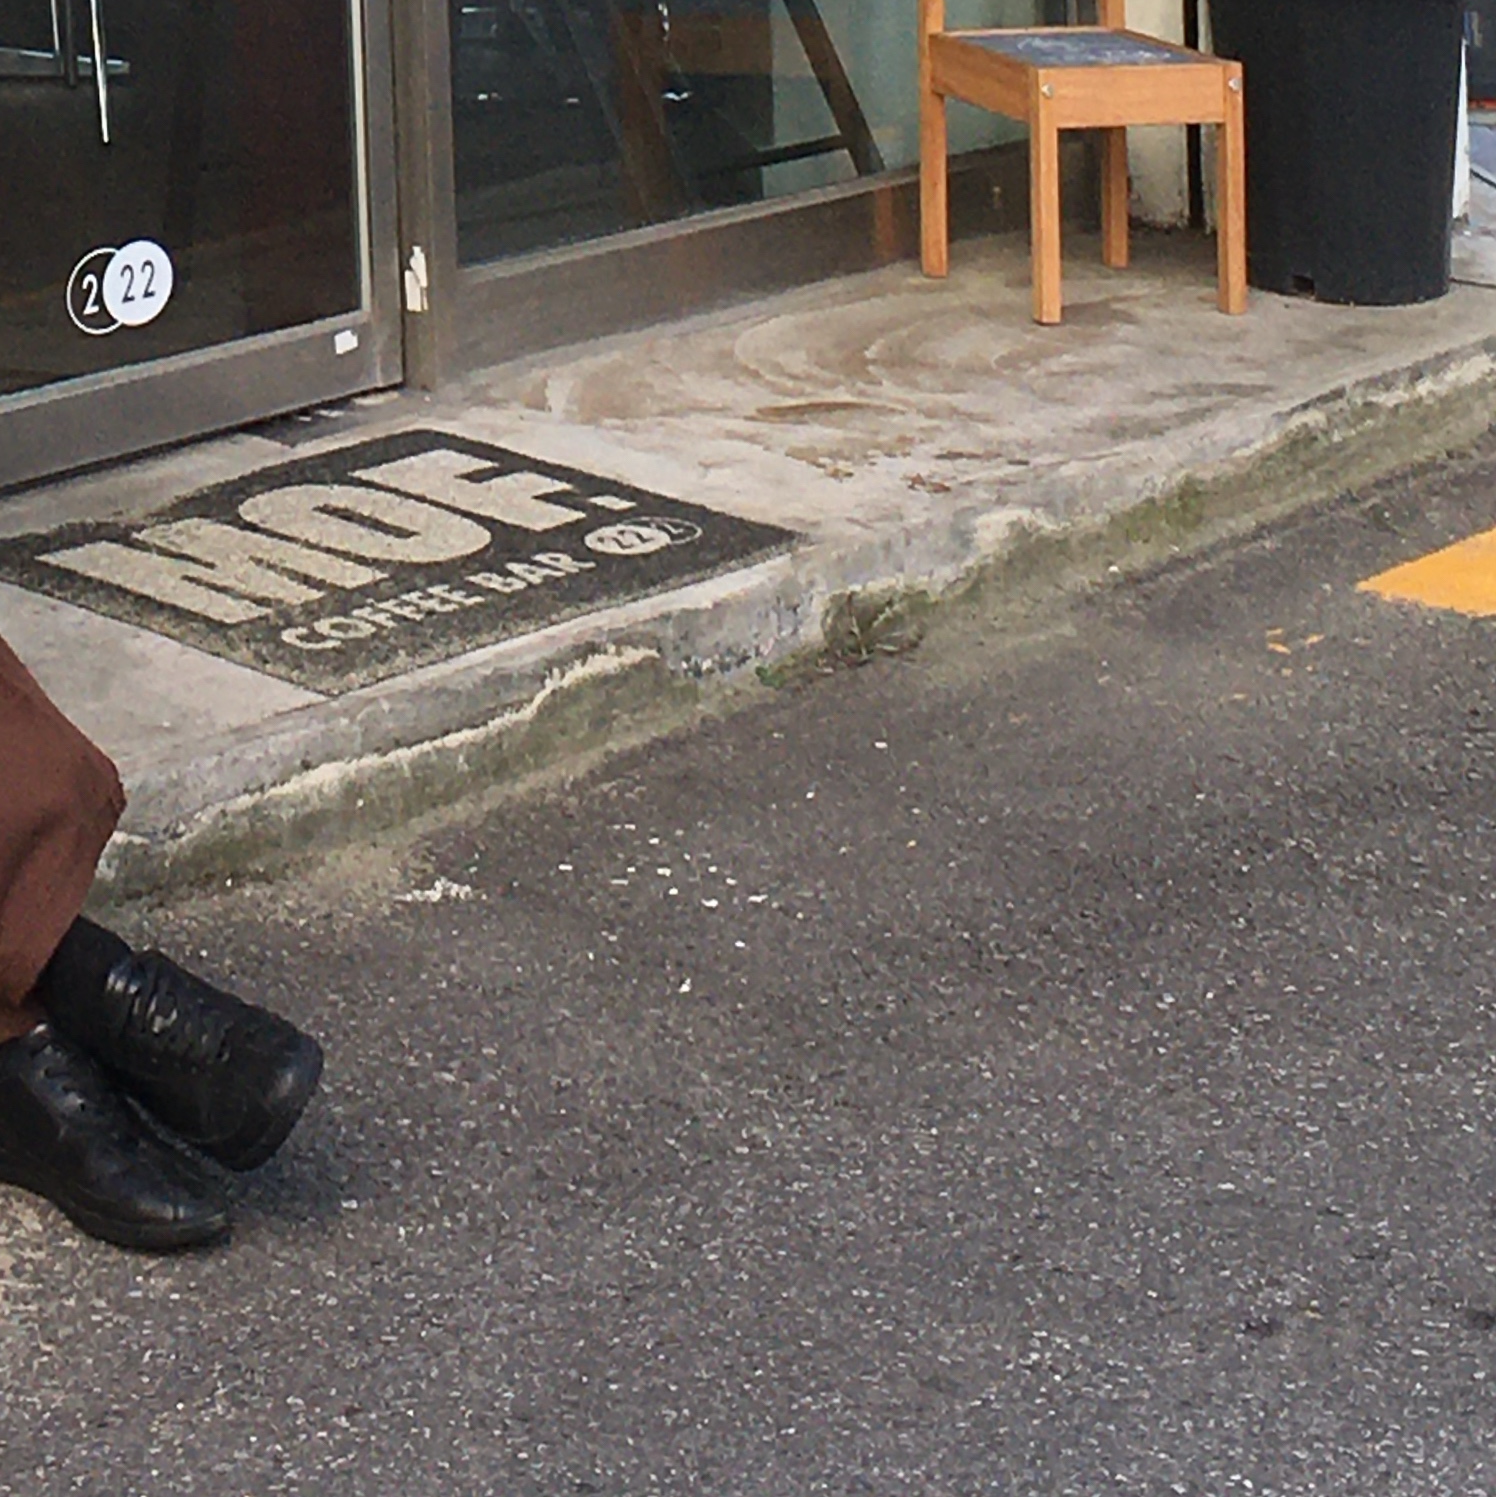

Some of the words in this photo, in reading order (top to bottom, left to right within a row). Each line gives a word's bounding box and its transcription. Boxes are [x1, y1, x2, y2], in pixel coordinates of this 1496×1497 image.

[81, 273, 100, 316] 2
[119, 259, 156, 303] 22
[34, 448, 638, 624] MOF.
[280, 583, 485, 650] COFFEE
[465, 551, 596, 594] BAR
[599, 527, 654, 551] 22
